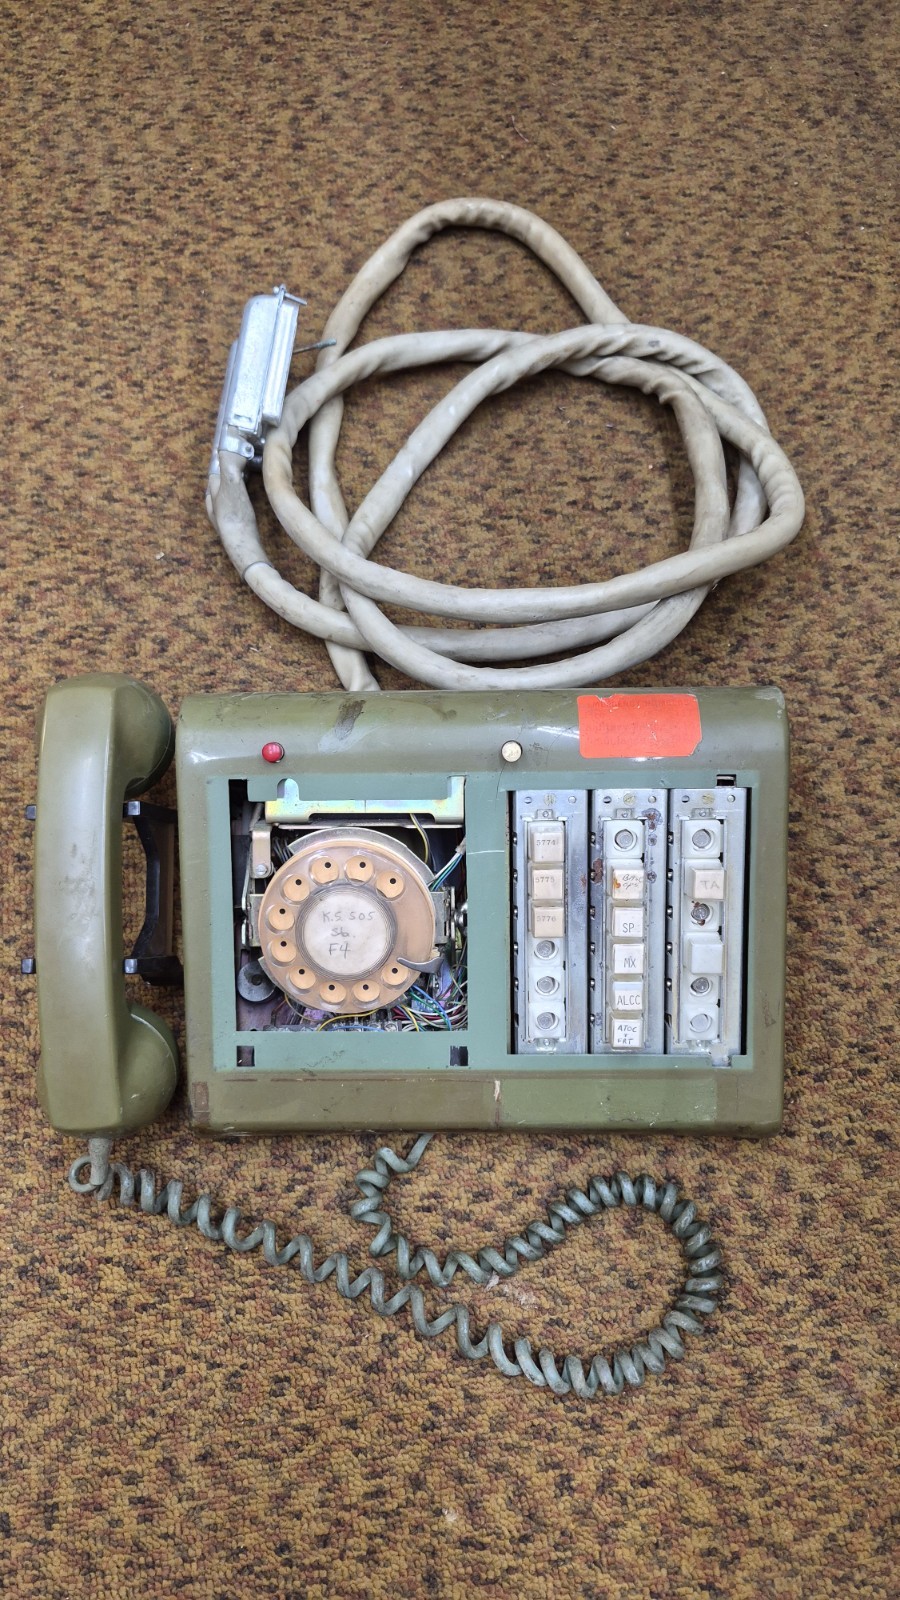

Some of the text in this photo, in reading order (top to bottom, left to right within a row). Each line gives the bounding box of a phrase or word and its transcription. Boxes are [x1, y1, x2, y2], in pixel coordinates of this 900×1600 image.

[699, 879, 720, 890] TA
[622, 922, 635, 933] SP
[328, 942, 351, 959] F4
[623, 957, 637, 968] MX
[616, 994, 641, 1006] ALCC
